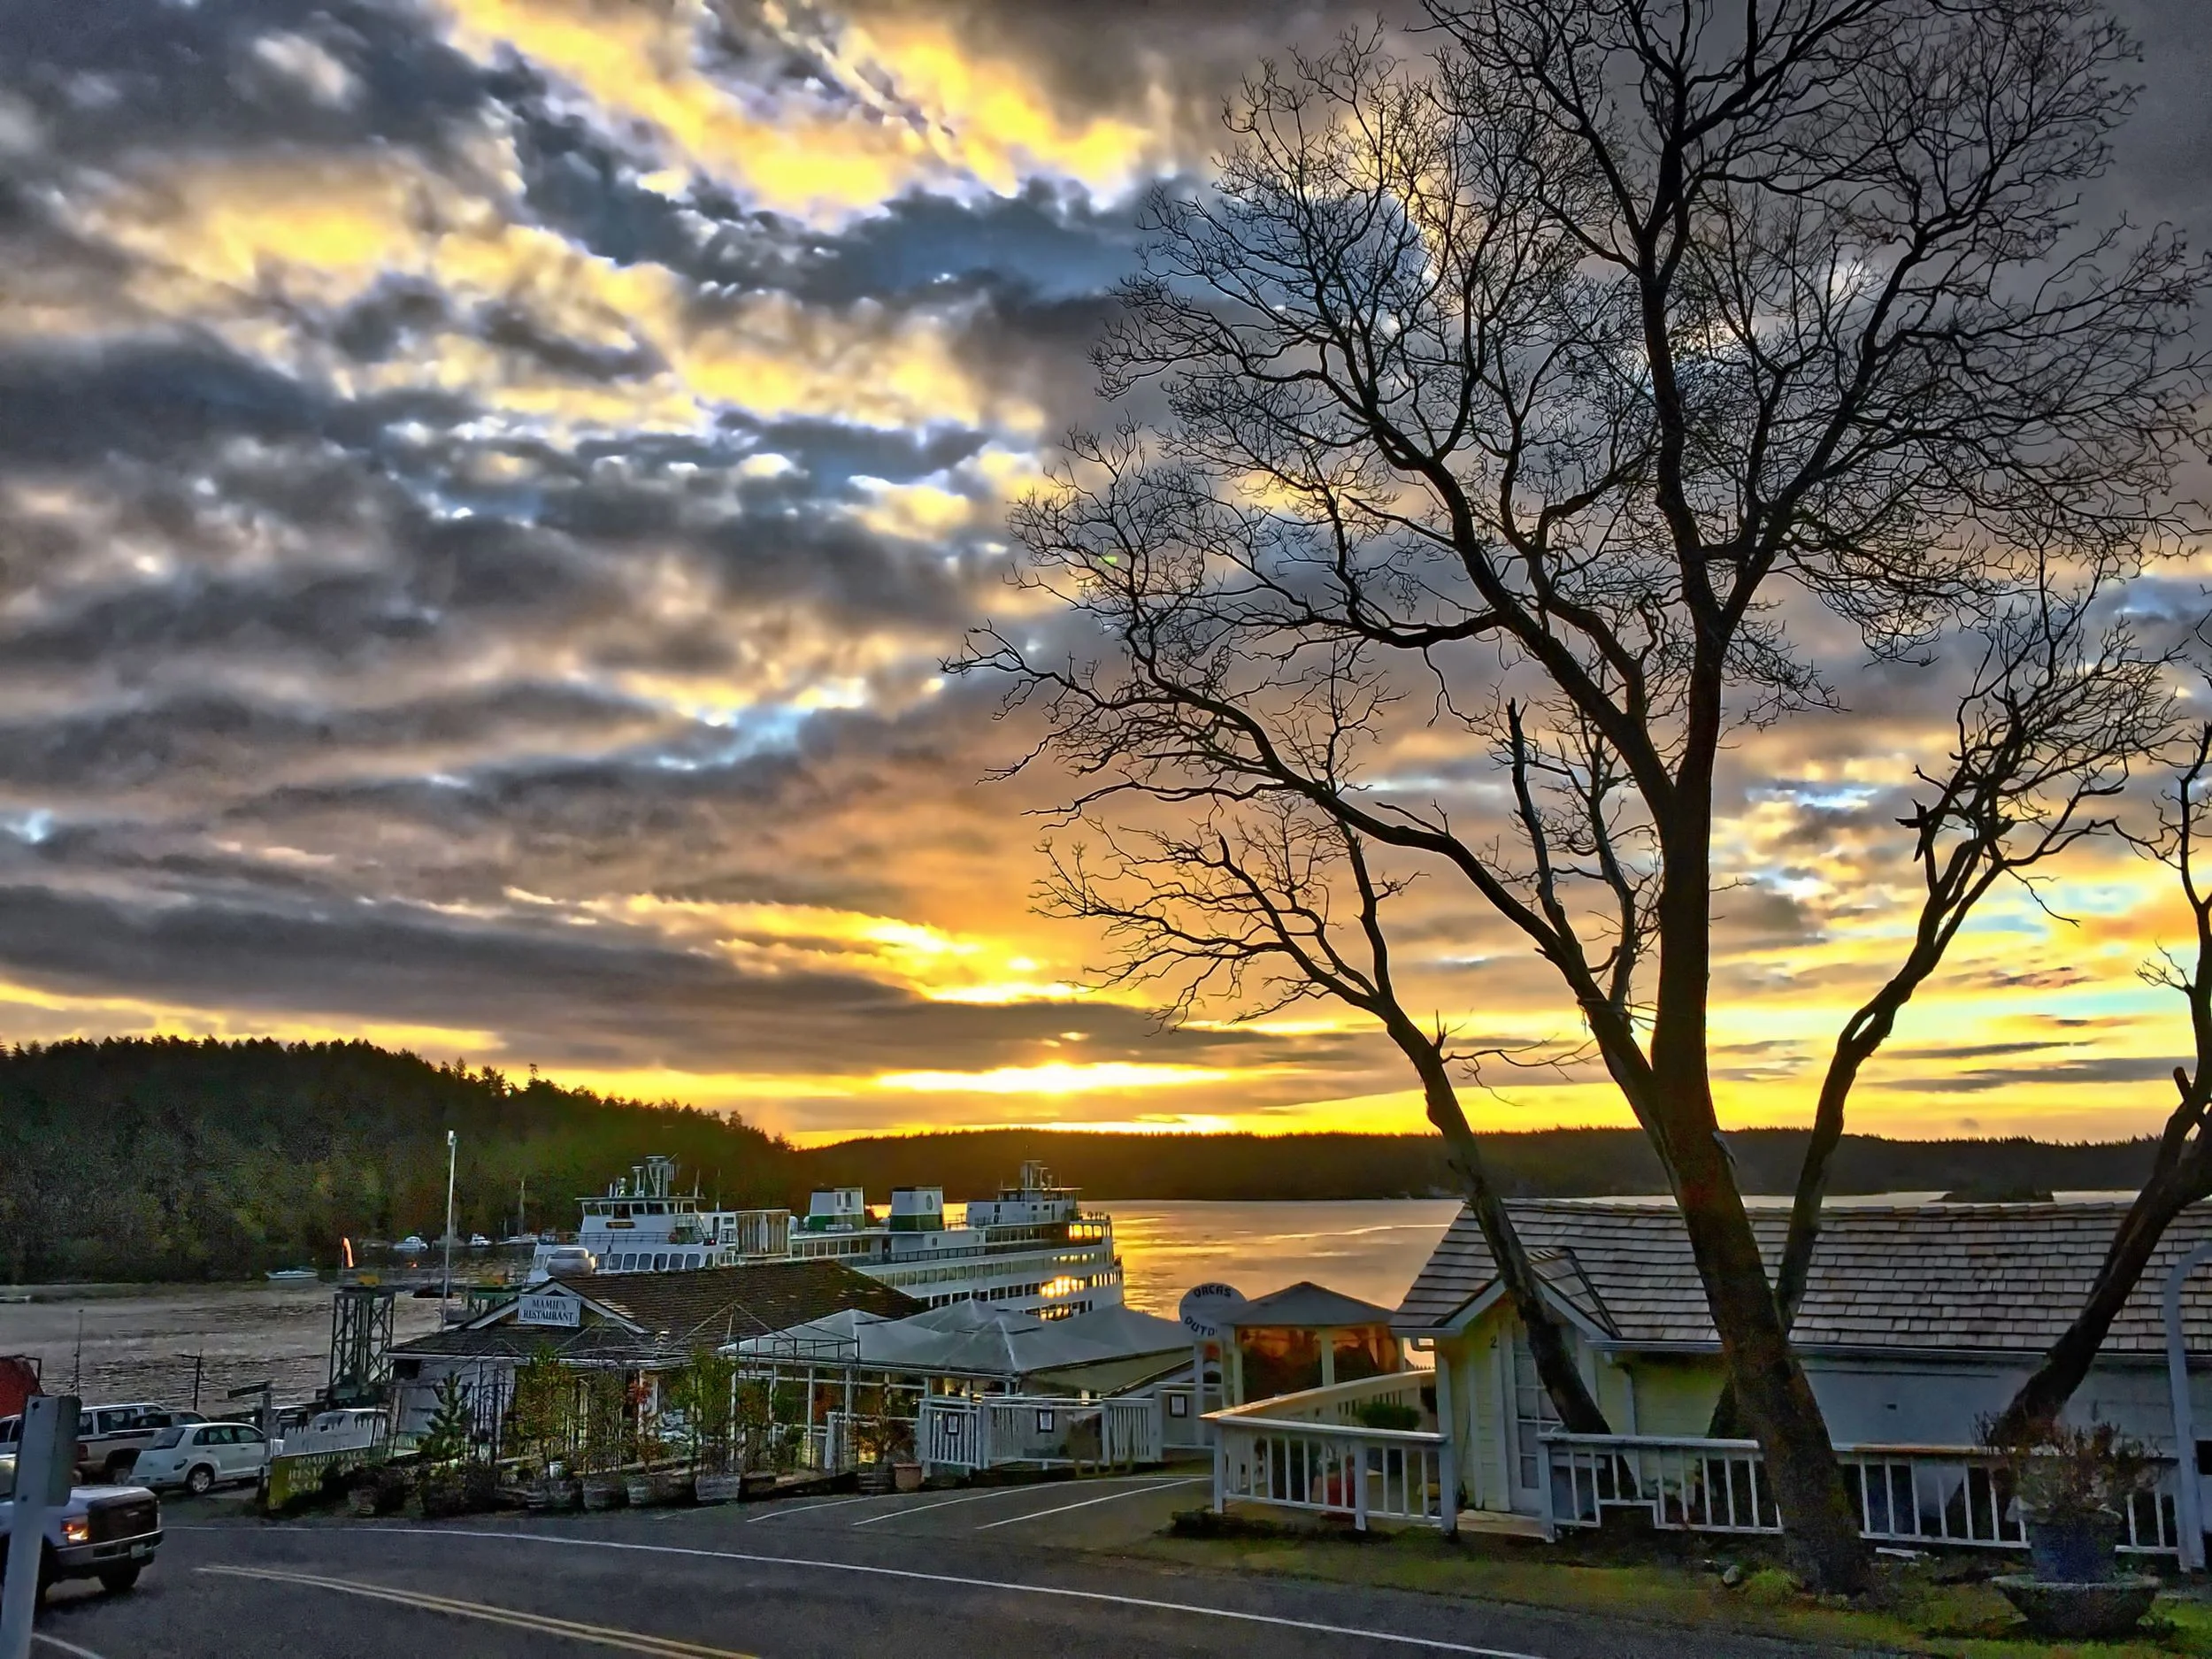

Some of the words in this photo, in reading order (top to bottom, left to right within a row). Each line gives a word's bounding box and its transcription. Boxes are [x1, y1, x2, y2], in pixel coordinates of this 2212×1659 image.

[1193, 1285, 1232, 1298] ORCAS
[523, 1310, 574, 1323] RESTAURANT
[1184, 1316, 1217, 1337] OUTD
